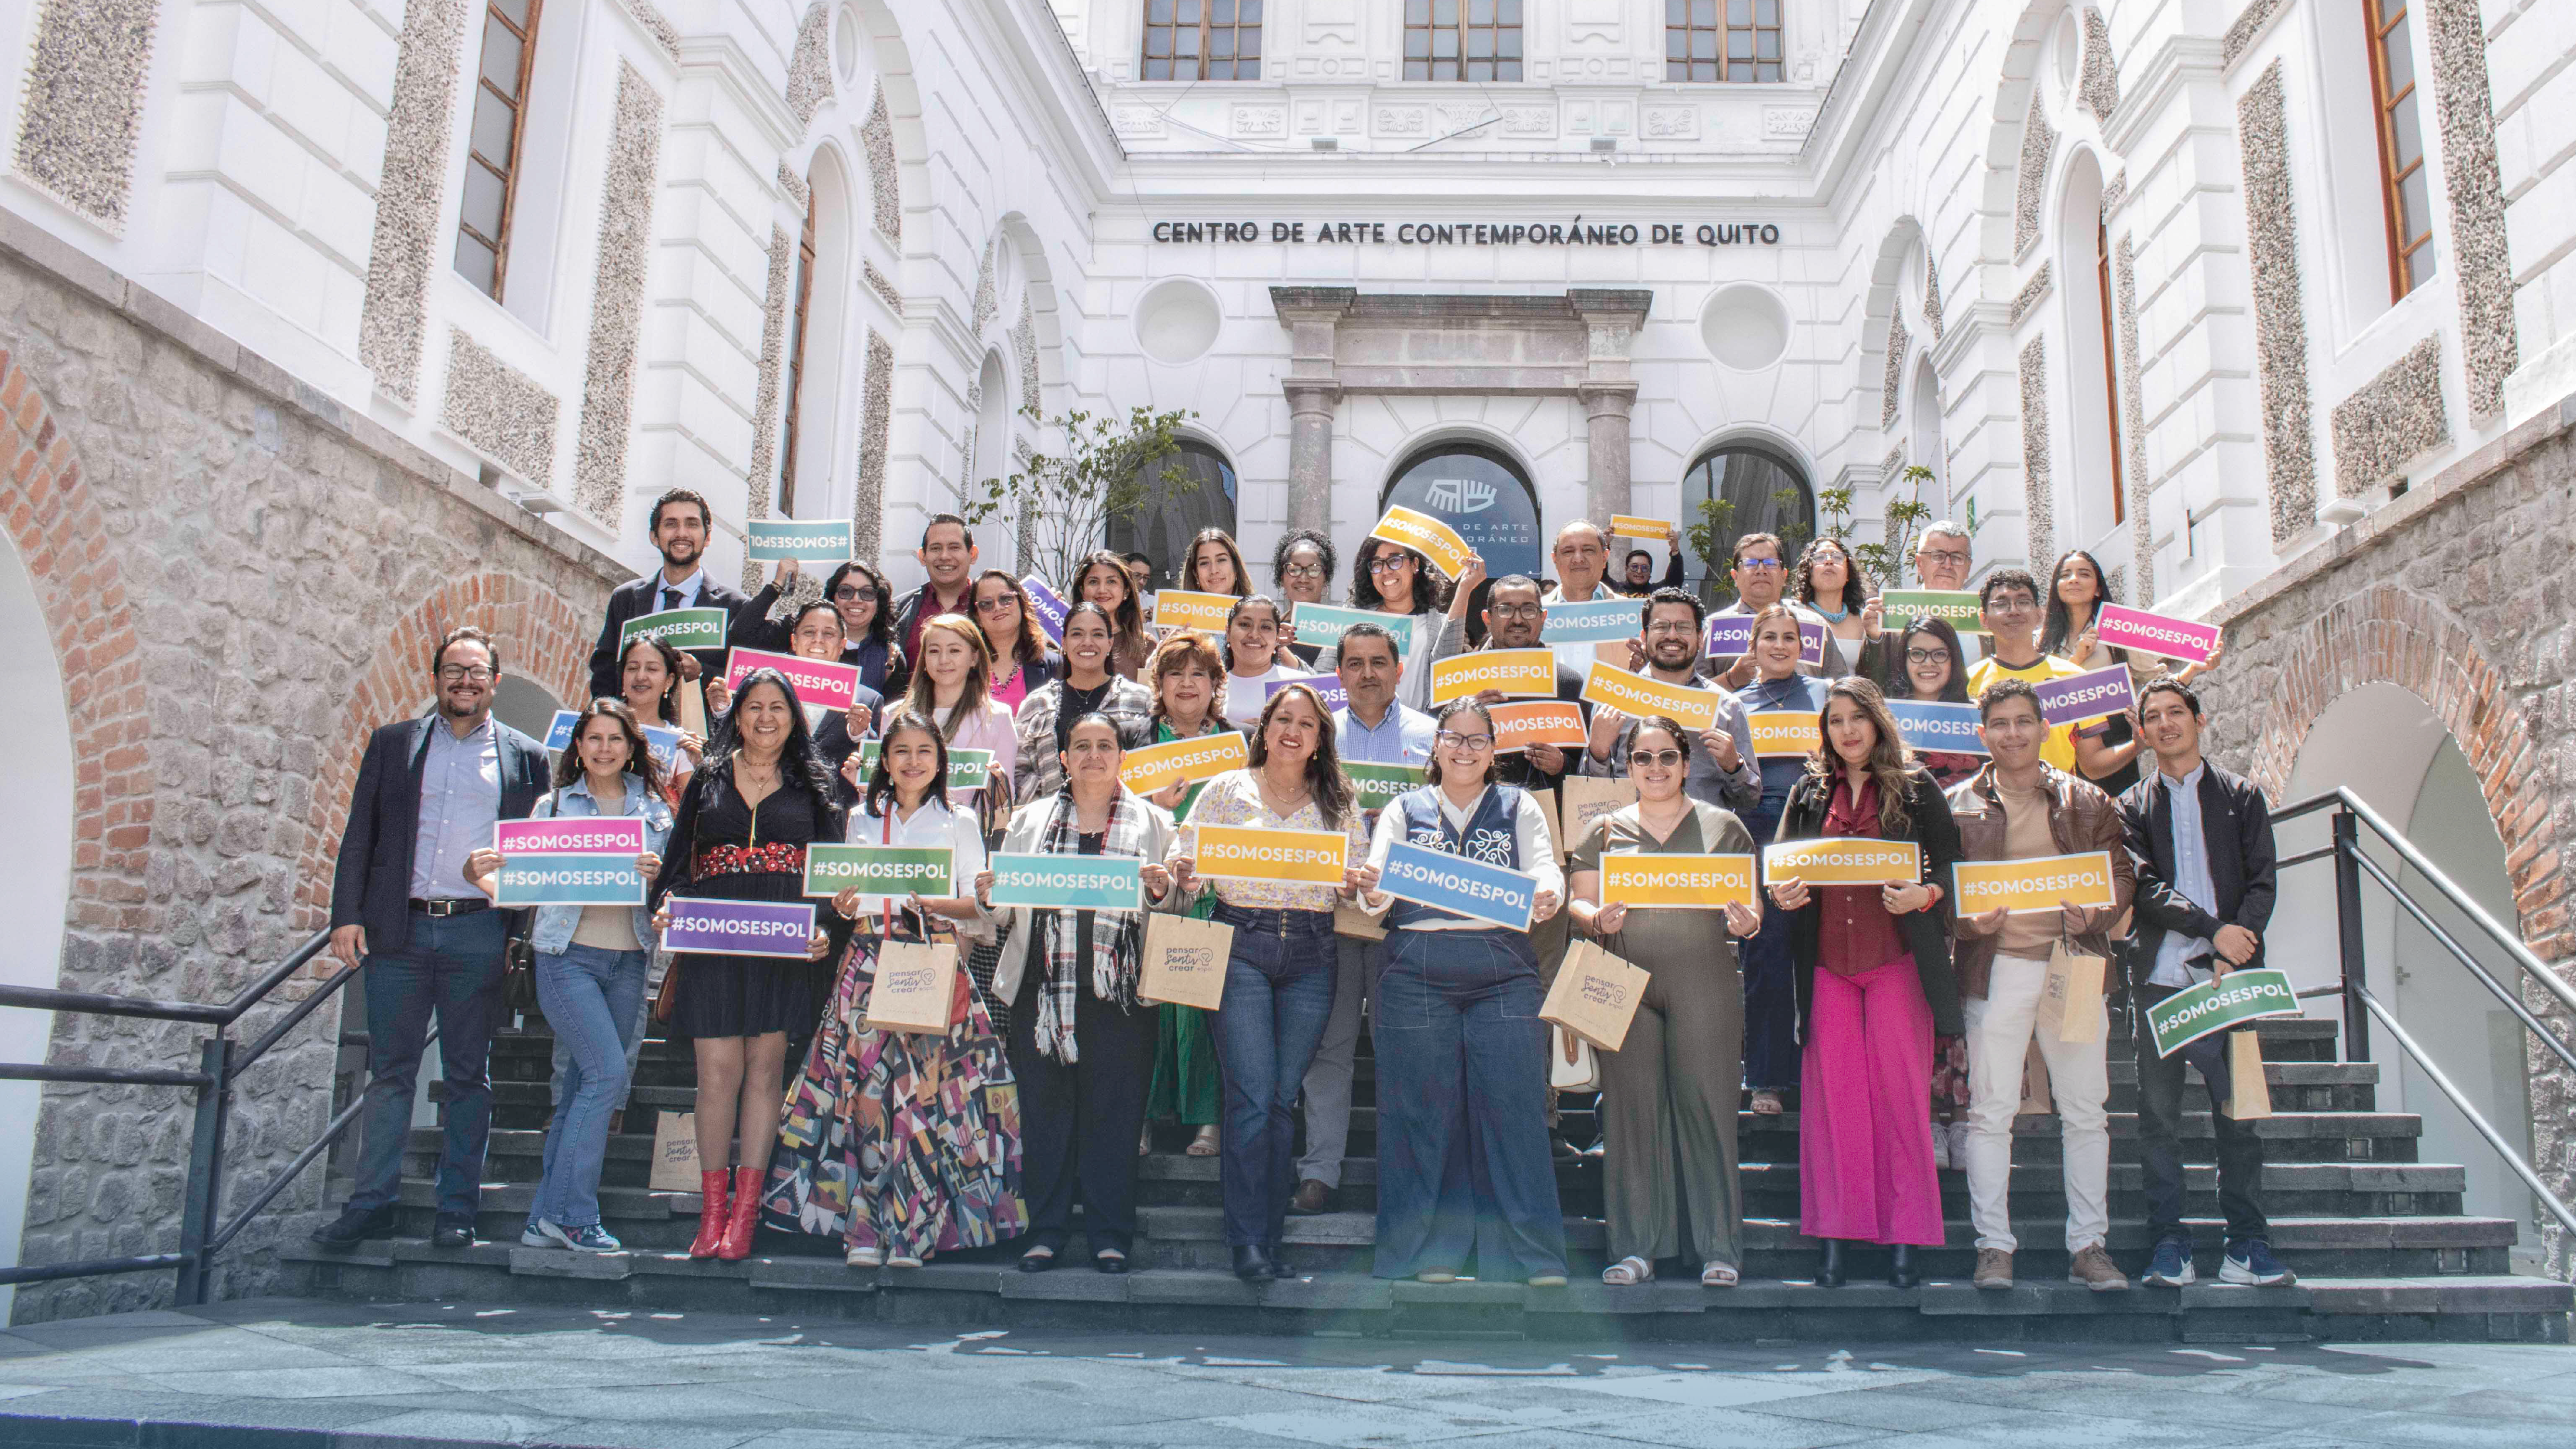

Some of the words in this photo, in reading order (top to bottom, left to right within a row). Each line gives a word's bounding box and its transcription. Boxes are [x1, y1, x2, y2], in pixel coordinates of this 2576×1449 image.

[1153, 222, 1258, 243] CENTRO
[1272, 222, 1304, 243] DE
[1317, 222, 1384, 243] ARTE
[1398, 214, 1638, 245] CONTEMPORÁNEO
[1652, 224, 1683, 244] DE
[1696, 224, 1779, 247] QUITO
[750, 535, 848, 548] #SOMOSESPOL
[1381, 517, 1466, 566] #SOMOSESPOL
[1544, 613, 1643, 629] SOMOSESPOL
[1885, 604, 1983, 618] #SOMOSESP
[2102, 617, 2211, 651] #SOMOSESPOL
[1436, 665, 1551, 688] #SOMOSESPOL
[1592, 675, 1712, 716] #SOMOSESPOL
[2041, 681, 2128, 711] MOSESPOL
[1121, 746, 1243, 782] #SOMOSESPOL
[502, 833, 639, 851] #SOMOSESPOL
[1200, 843, 1341, 866] #SOMOSESPOL
[1771, 853, 1913, 867] #SOMOSESPOL
[502, 870, 639, 886] #SOMOSESPOL
[813, 861, 948, 879] #SOMOSESPOL
[1608, 872, 1748, 888] #SOMOSESPOL
[997, 871, 1135, 891] #SOMOSESPOL
[1388, 859, 1527, 910] #SOMOSESPOL
[1964, 871, 2106, 896] #SOMOSESPOL
[671, 916, 806, 938] #SOMOSESPOL
[1166, 946, 1199, 956] pensar
[889, 970, 921, 979] pensar
[1586, 975, 1614, 988] pensar
[1584, 993, 1607, 1005] crear
[2158, 984, 2290, 1035] #SOMOSESPOL
